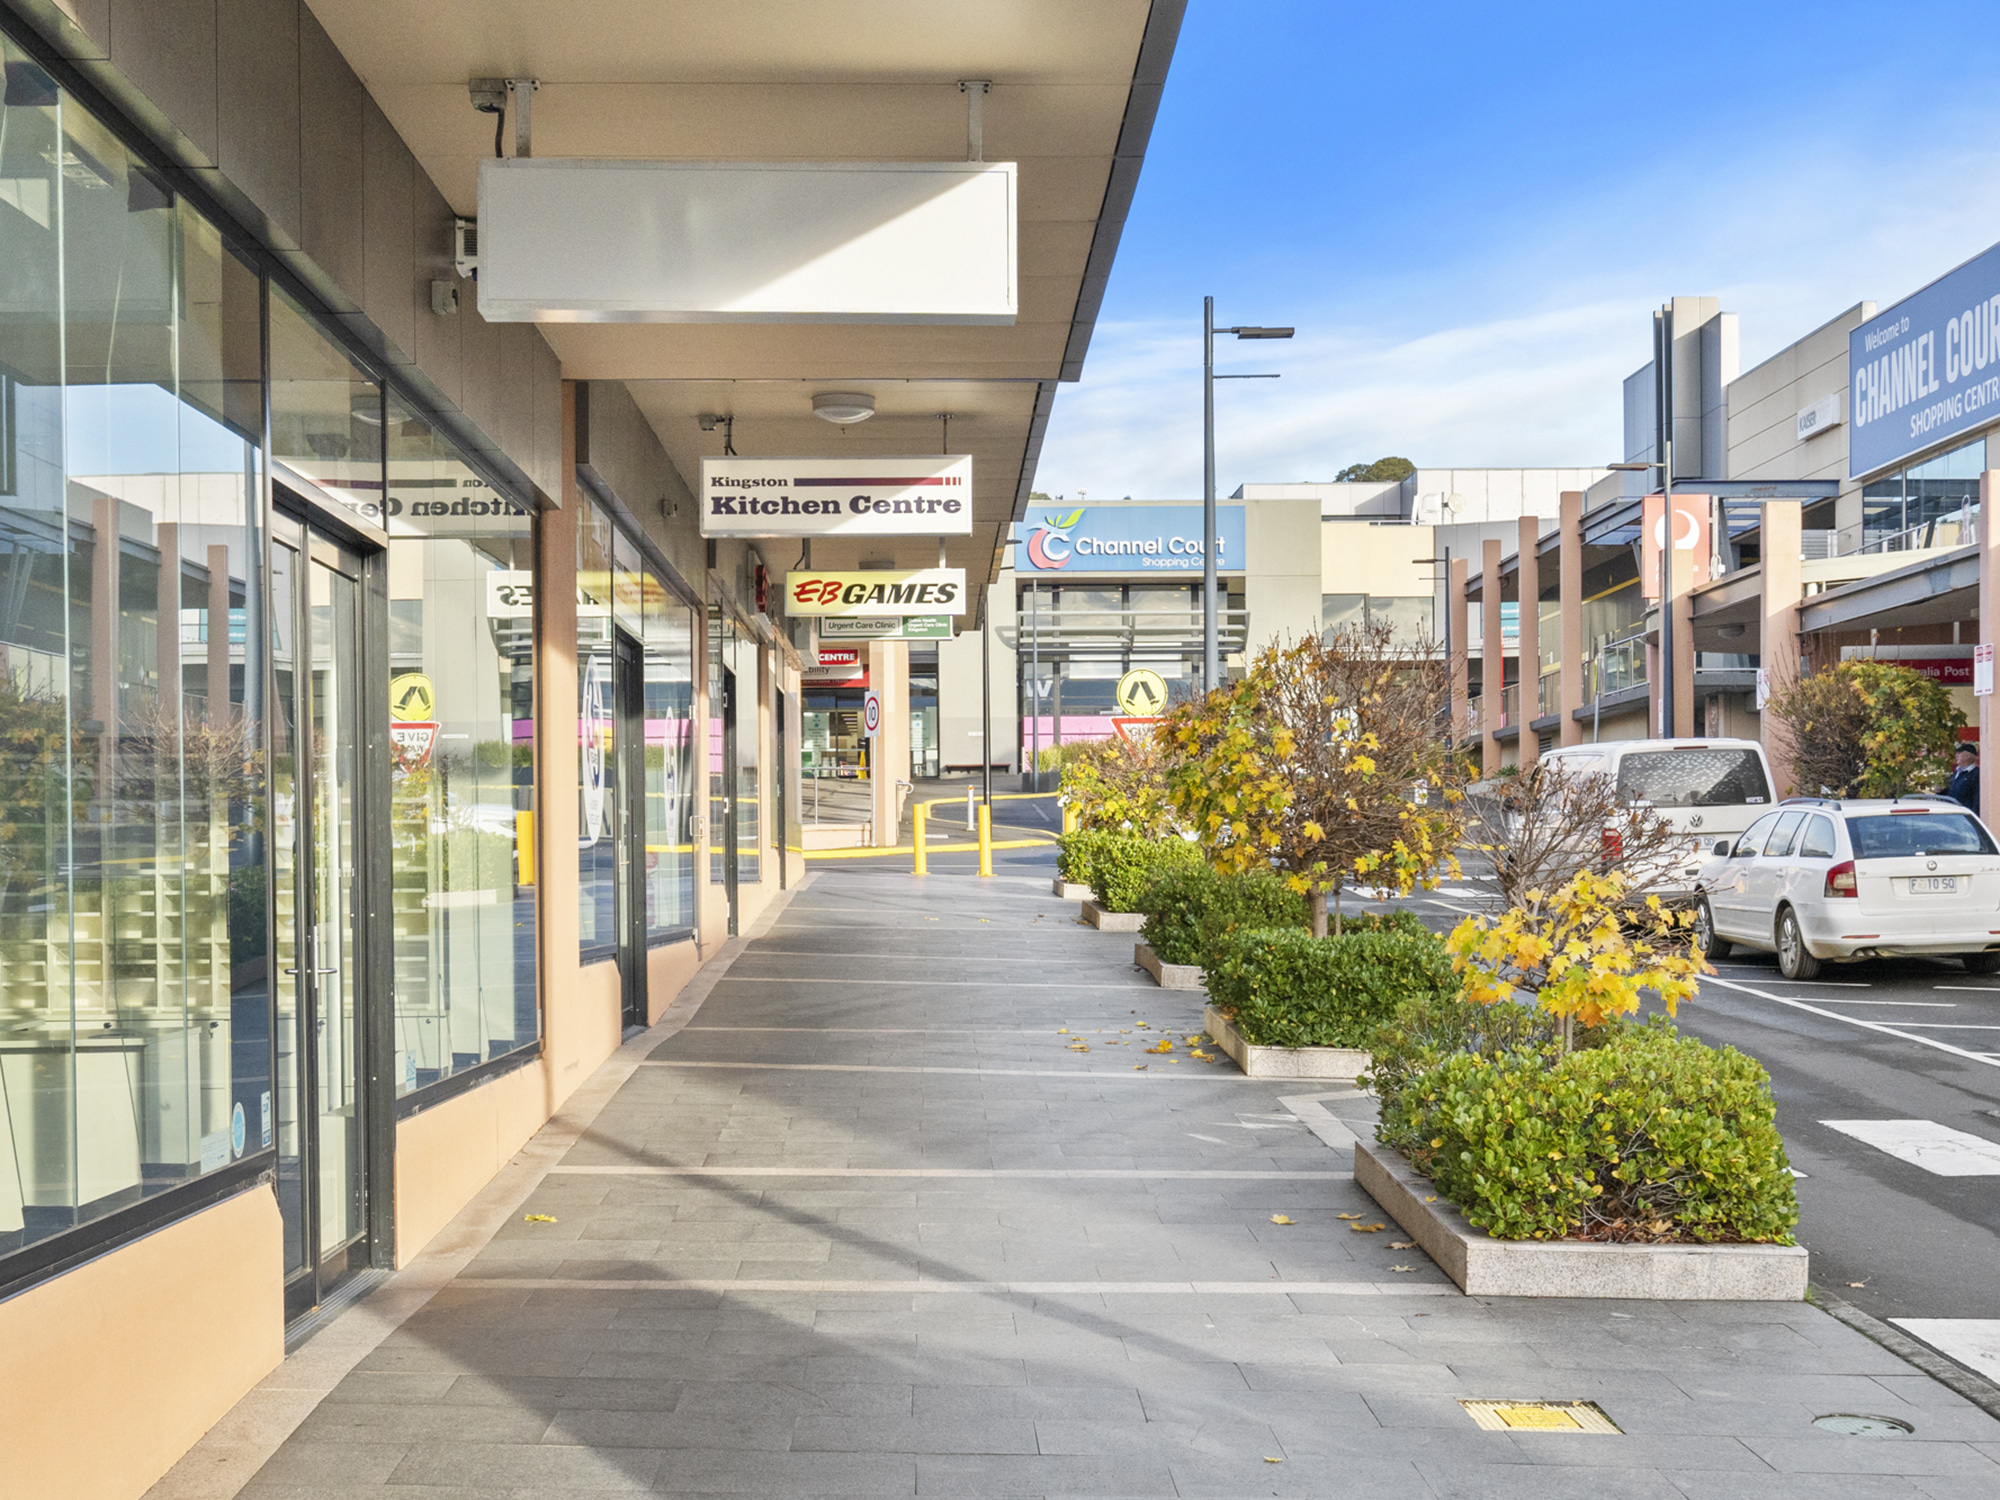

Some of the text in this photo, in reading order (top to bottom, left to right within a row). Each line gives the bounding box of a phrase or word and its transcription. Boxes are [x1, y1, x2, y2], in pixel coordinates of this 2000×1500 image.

[1865, 316, 1910, 352] Welcome to
[1855, 329, 1939, 428] CHANNEL
[1910, 374, 2000, 438] SHOPPING CENTR
[711, 476, 788, 489] Kingston
[711, 495, 961, 515] Kitchen Centre
[1075, 536, 1225, 555] Channel Cout
[1142, 557, 1225, 568] Shopping Cere
[794, 580, 958, 605] EB GAMES
[828, 622, 854, 630] Urgent
[875, 621, 896, 629] Clinic
[819, 653, 855, 661] CENTRE
[804, 666, 830, 674] bility
[1945, 666, 1969, 676] Post
[869, 706, 876, 721] 10
